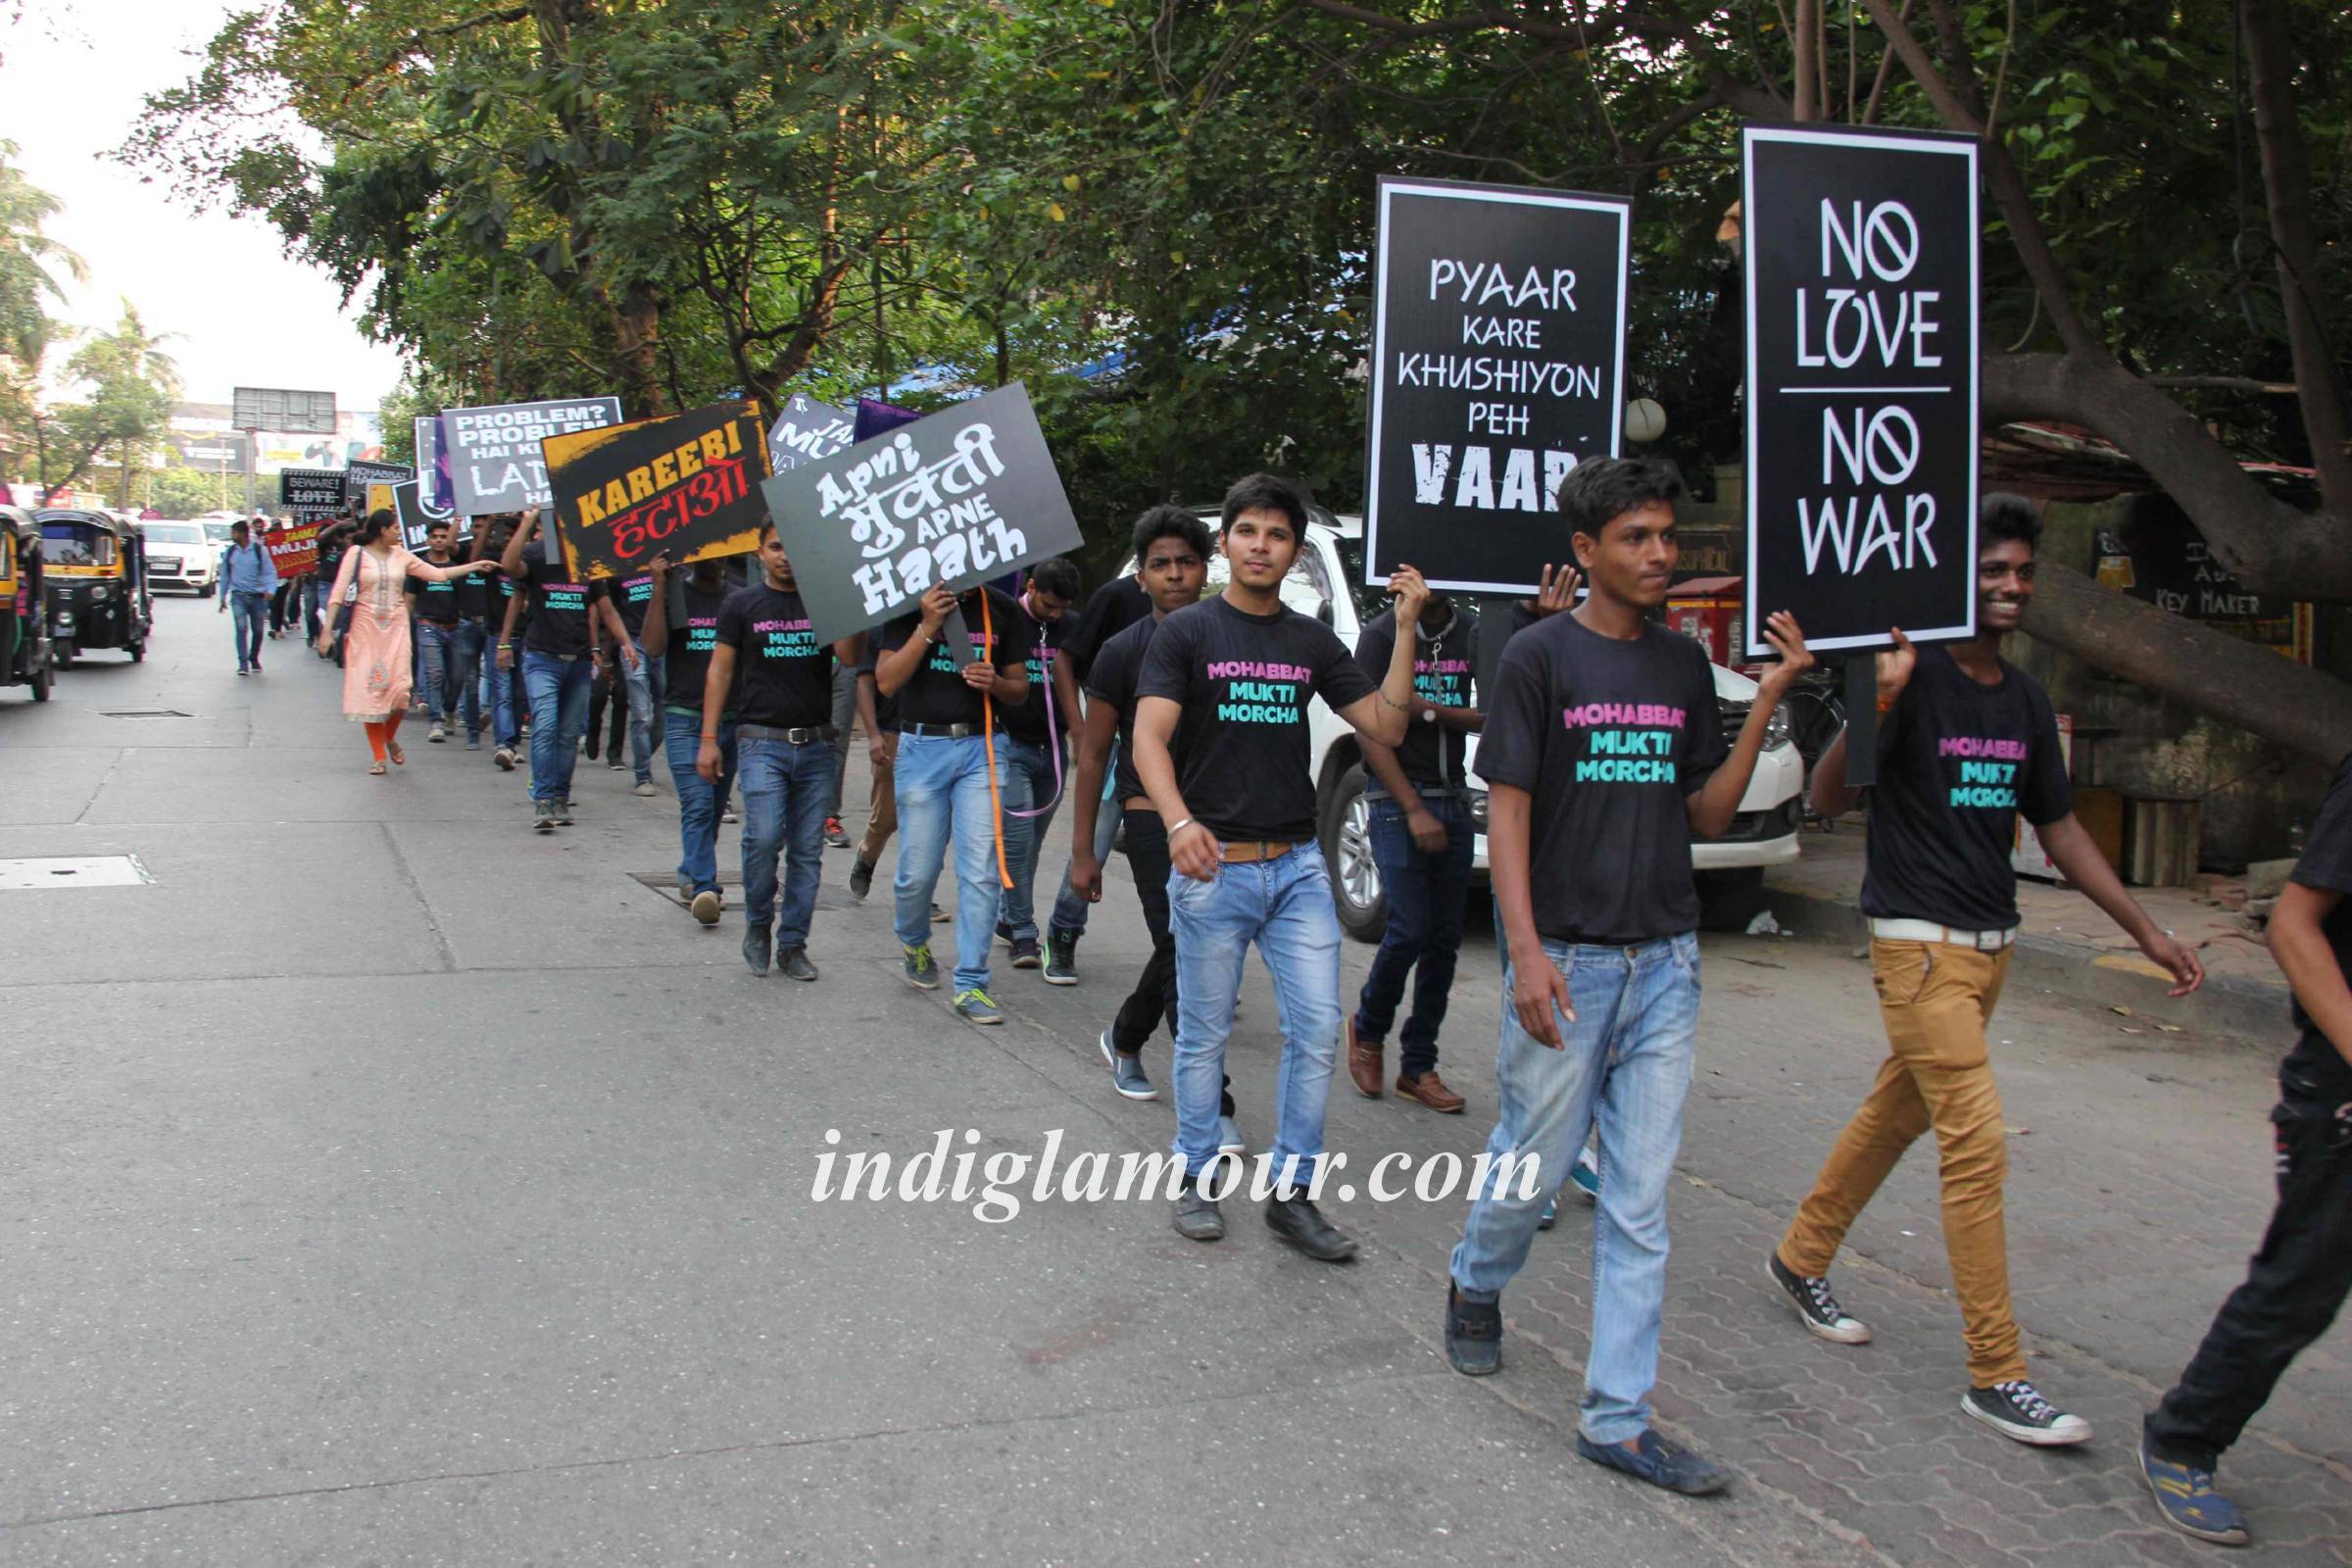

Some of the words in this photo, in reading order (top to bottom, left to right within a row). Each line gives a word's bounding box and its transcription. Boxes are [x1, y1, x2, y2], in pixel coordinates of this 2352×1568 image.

[1821, 198, 1919, 282] NO
[1430, 259, 1577, 313] PYAAR
[1463, 315, 1542, 349] KARE
[1796, 287, 1942, 369] LOVE
[1397, 352, 1600, 400] KHUSHIYON
[455, 405, 606, 429] PROBLEM?
[1468, 402, 1531, 436] PEH
[471, 445, 510, 460] HAI
[1823, 405, 1920, 485] NO
[289, 477, 340, 490] BEWARE!
[576, 419, 742, 527] KAREEBI
[815, 432, 920, 517] Apni
[293, 490, 335, 503] LOVE
[606, 456, 749, 559] हटाओ
[917, 492, 997, 545] APNE
[1797, 493, 1938, 576] WAR
[852, 516, 1027, 616] Haath
[2157, 589, 2187, 612] KEY
[2201, 590, 2260, 614] MAKER
[763, 646, 820, 659] MORCHA
[768, 632, 815, 645] MUKTI
[1206, 662, 1313, 683] MOHABBAT
[1229, 681, 1297, 703] MUKTI
[1217, 705, 1298, 723] MORCHA
[1591, 730, 1672, 756] MUKTI
[1576, 760, 1675, 783] MORCHA
